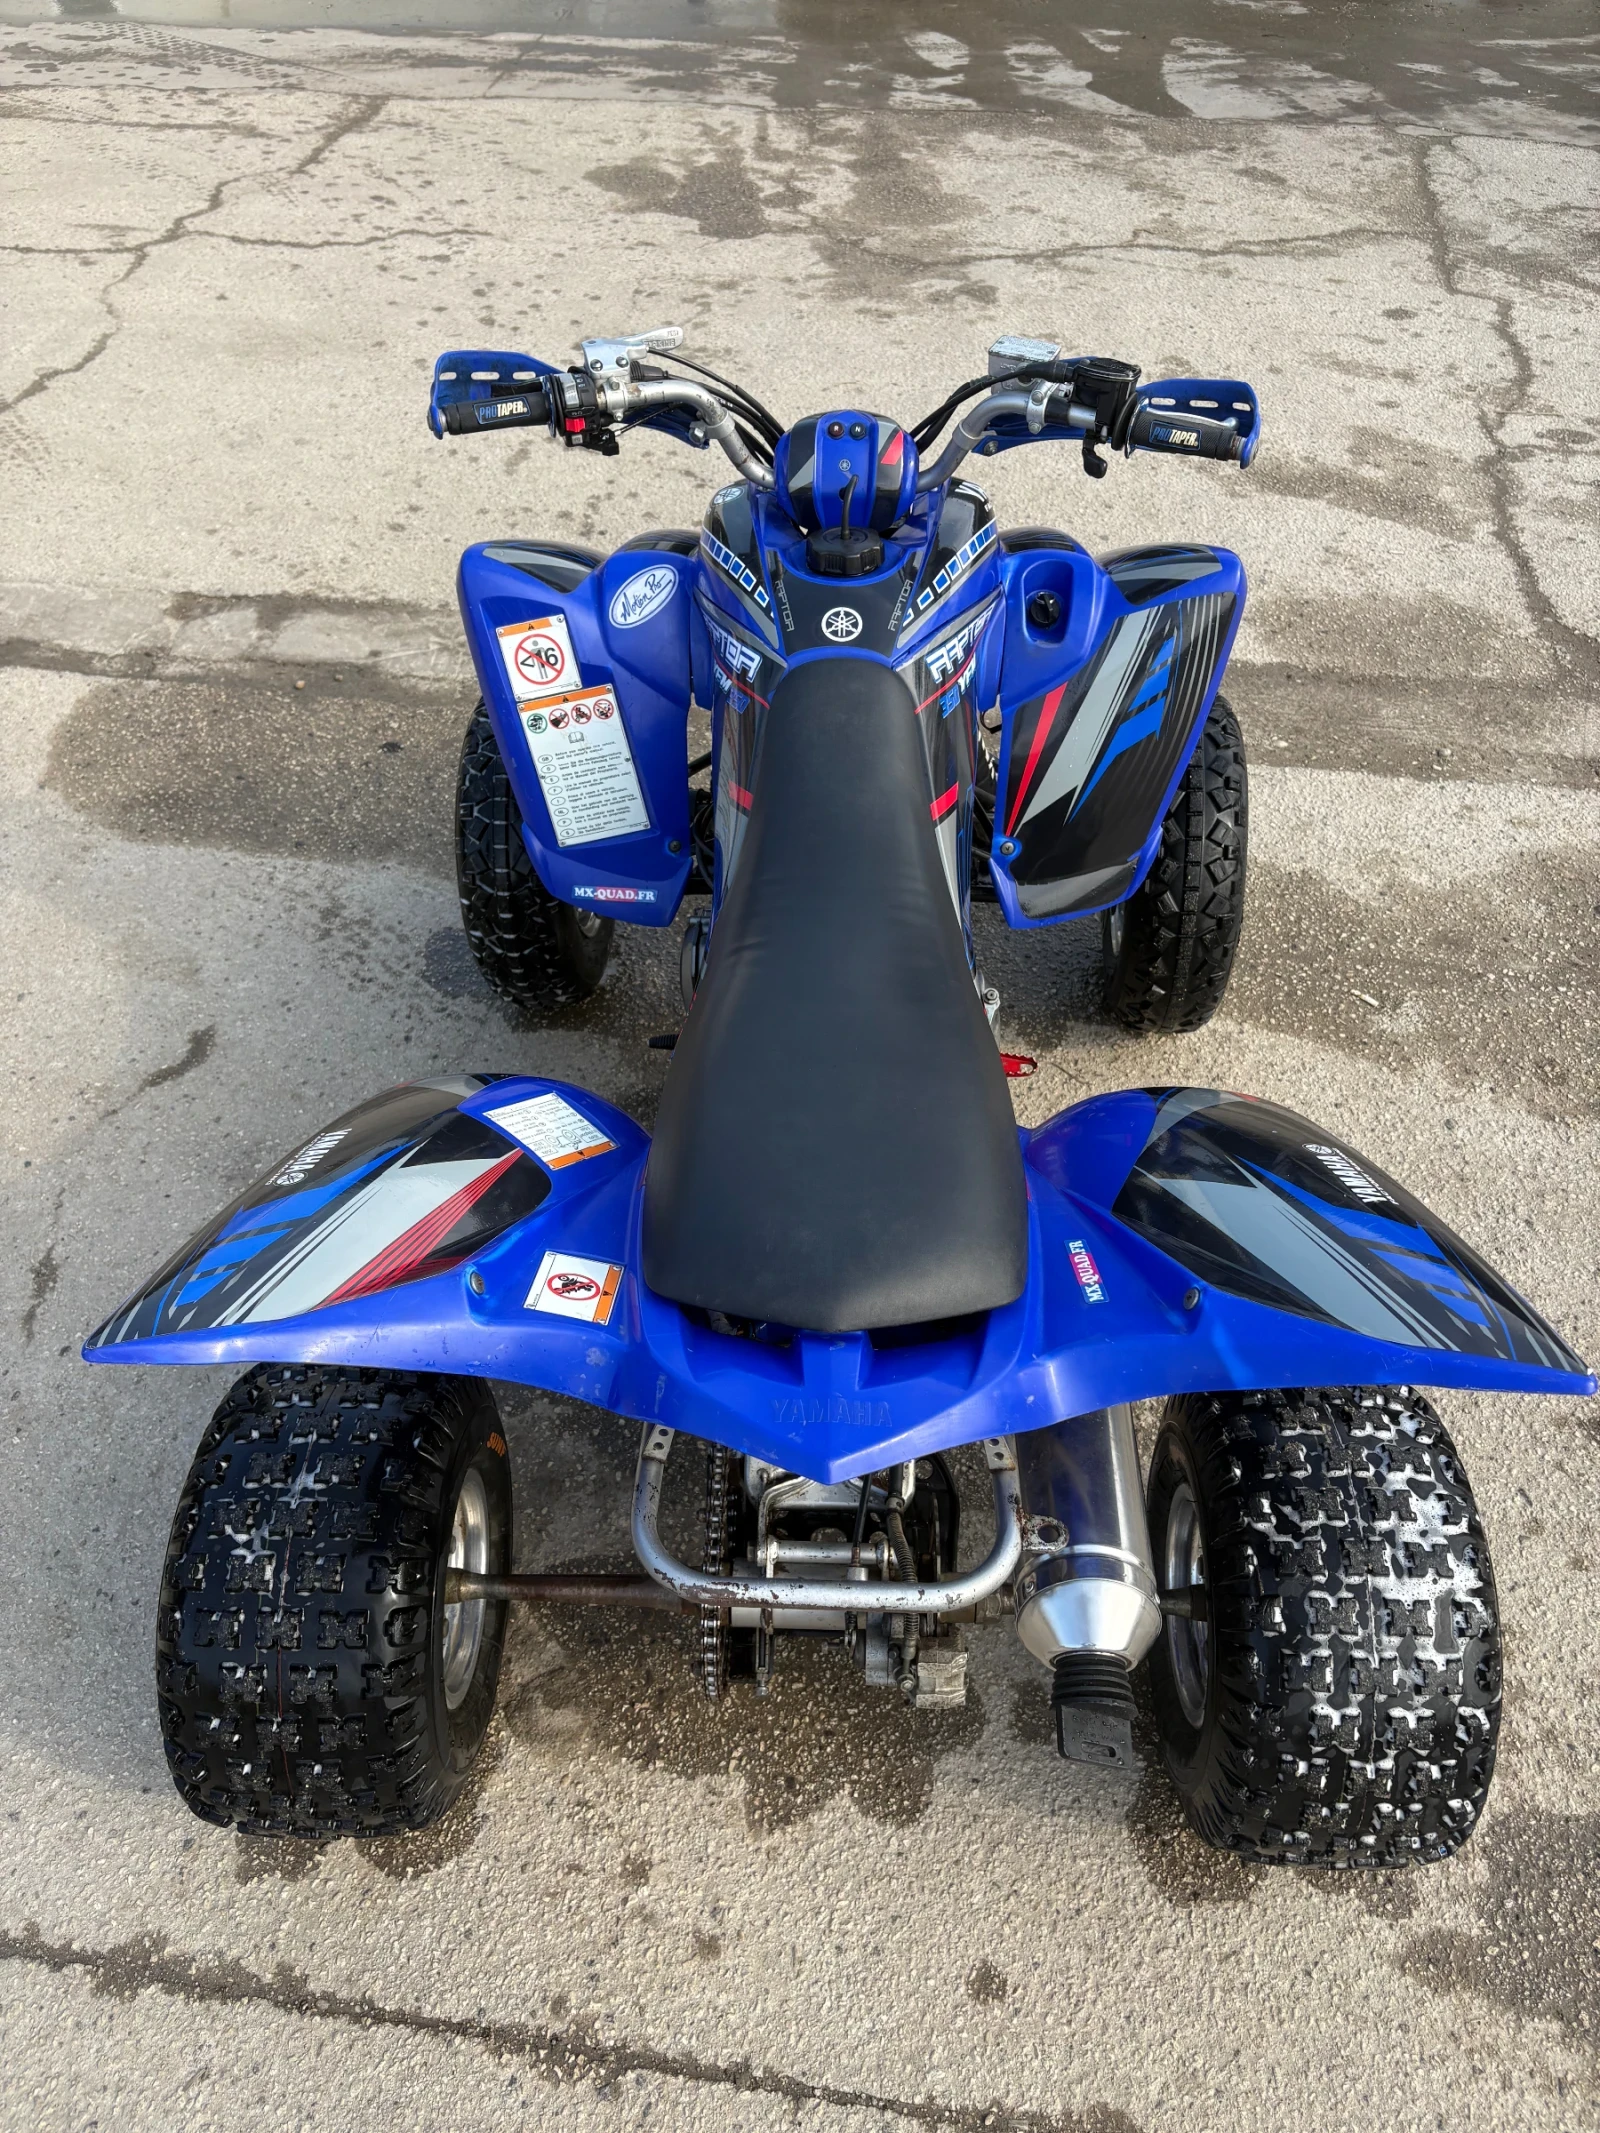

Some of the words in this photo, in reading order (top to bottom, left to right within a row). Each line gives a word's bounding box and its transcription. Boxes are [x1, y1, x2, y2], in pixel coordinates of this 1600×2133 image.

[621, 592, 653, 622] Motion
[644, 573, 667, 594] Pro
[888, 579, 914, 632] RAPTOR
[939, 684, 961, 719] 350
[574, 887, 655, 901] MX-QUAD.FR
[285, 1127, 353, 1173] YAMAHA
[1316, 1155, 1388, 1203] YAMAHA
[1069, 1240, 1104, 1302] MX-QUAD.FR
[772, 1397, 893, 1427] YAMAHA
